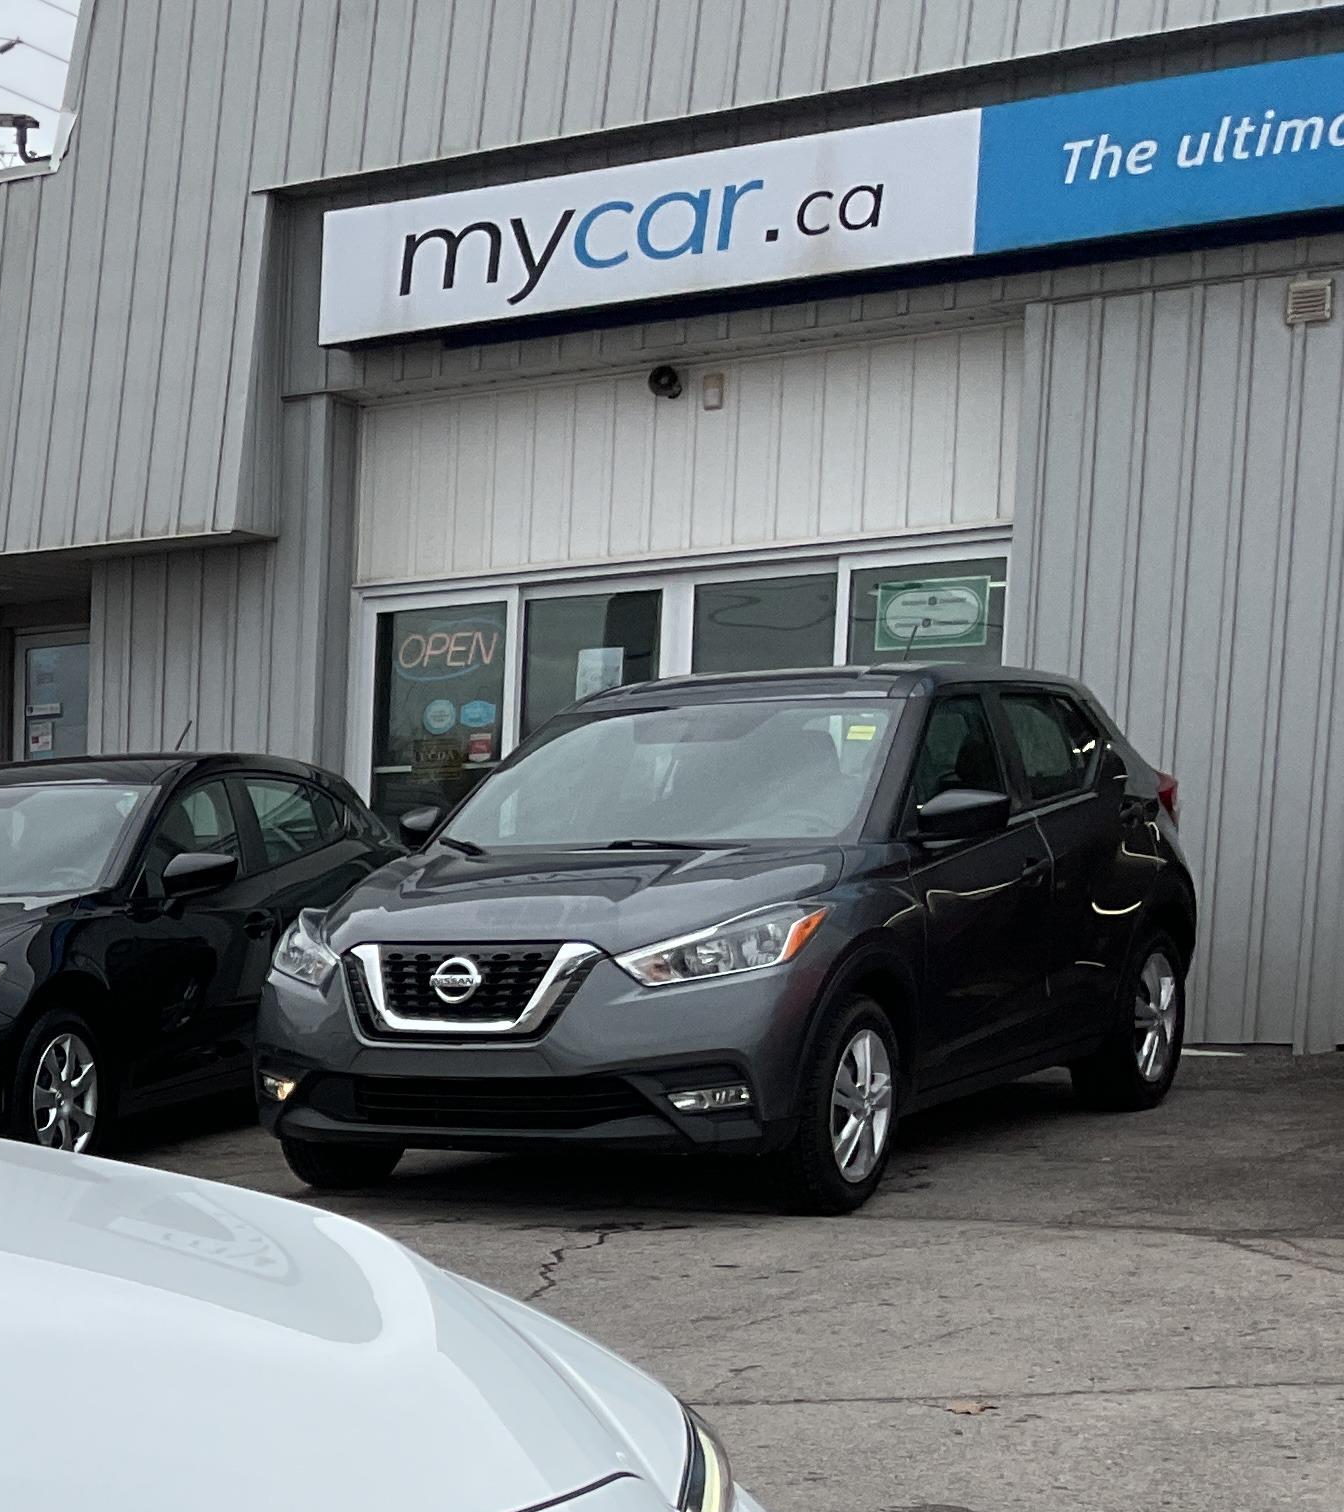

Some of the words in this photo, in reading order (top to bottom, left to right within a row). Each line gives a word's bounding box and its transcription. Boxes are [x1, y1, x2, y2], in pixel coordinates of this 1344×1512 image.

[1063, 133, 1158, 185] The
[398, 631, 499, 669] OPEN
[431, 976, 475, 987] NISSAN
